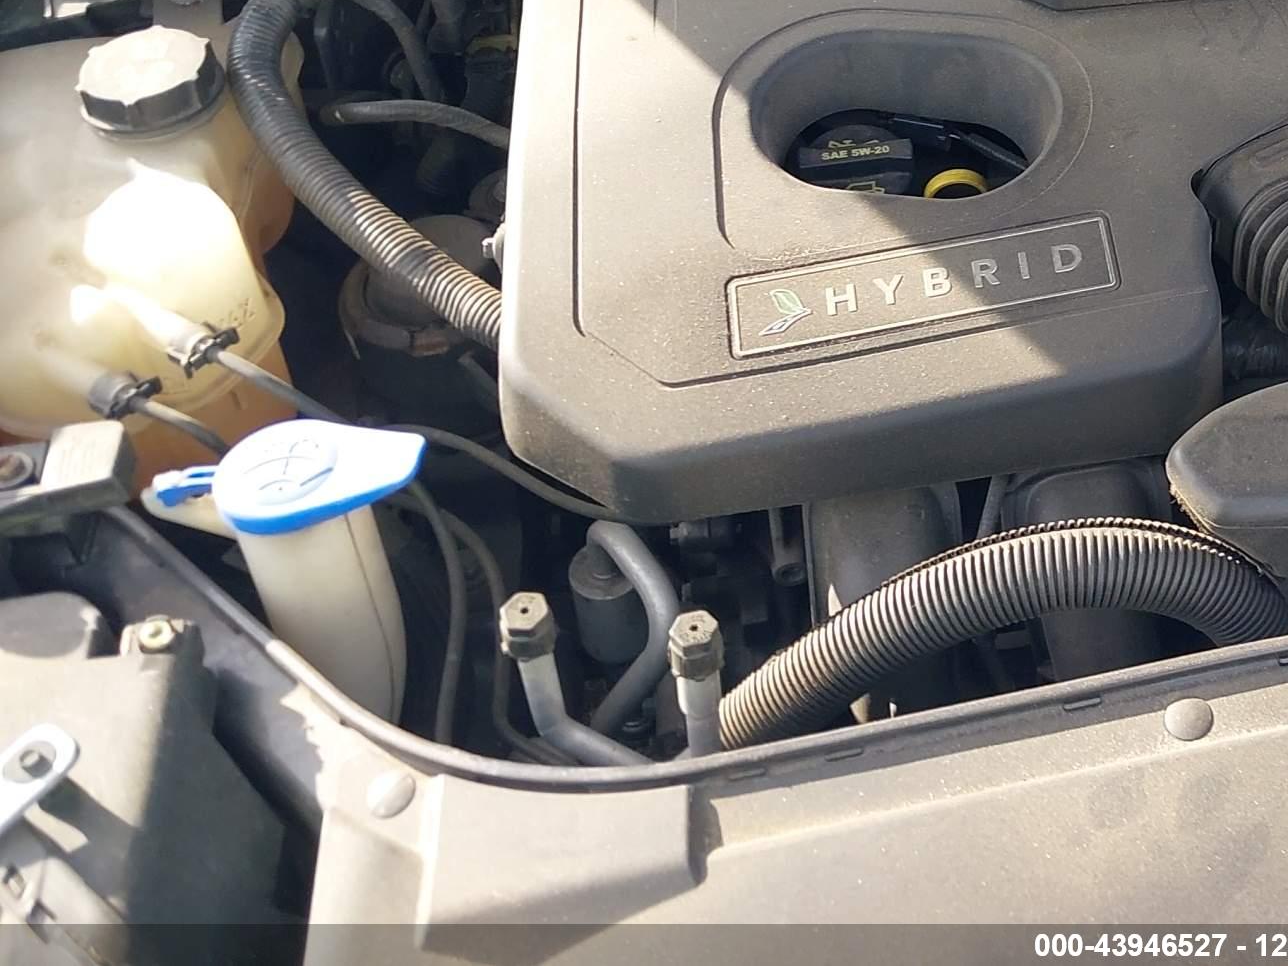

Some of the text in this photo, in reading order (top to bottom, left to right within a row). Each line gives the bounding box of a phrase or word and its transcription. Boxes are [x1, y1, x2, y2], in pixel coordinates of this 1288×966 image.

[821, 145, 890, 161] SAE 5W-20
[825, 244, 1082, 315] HYBRID
